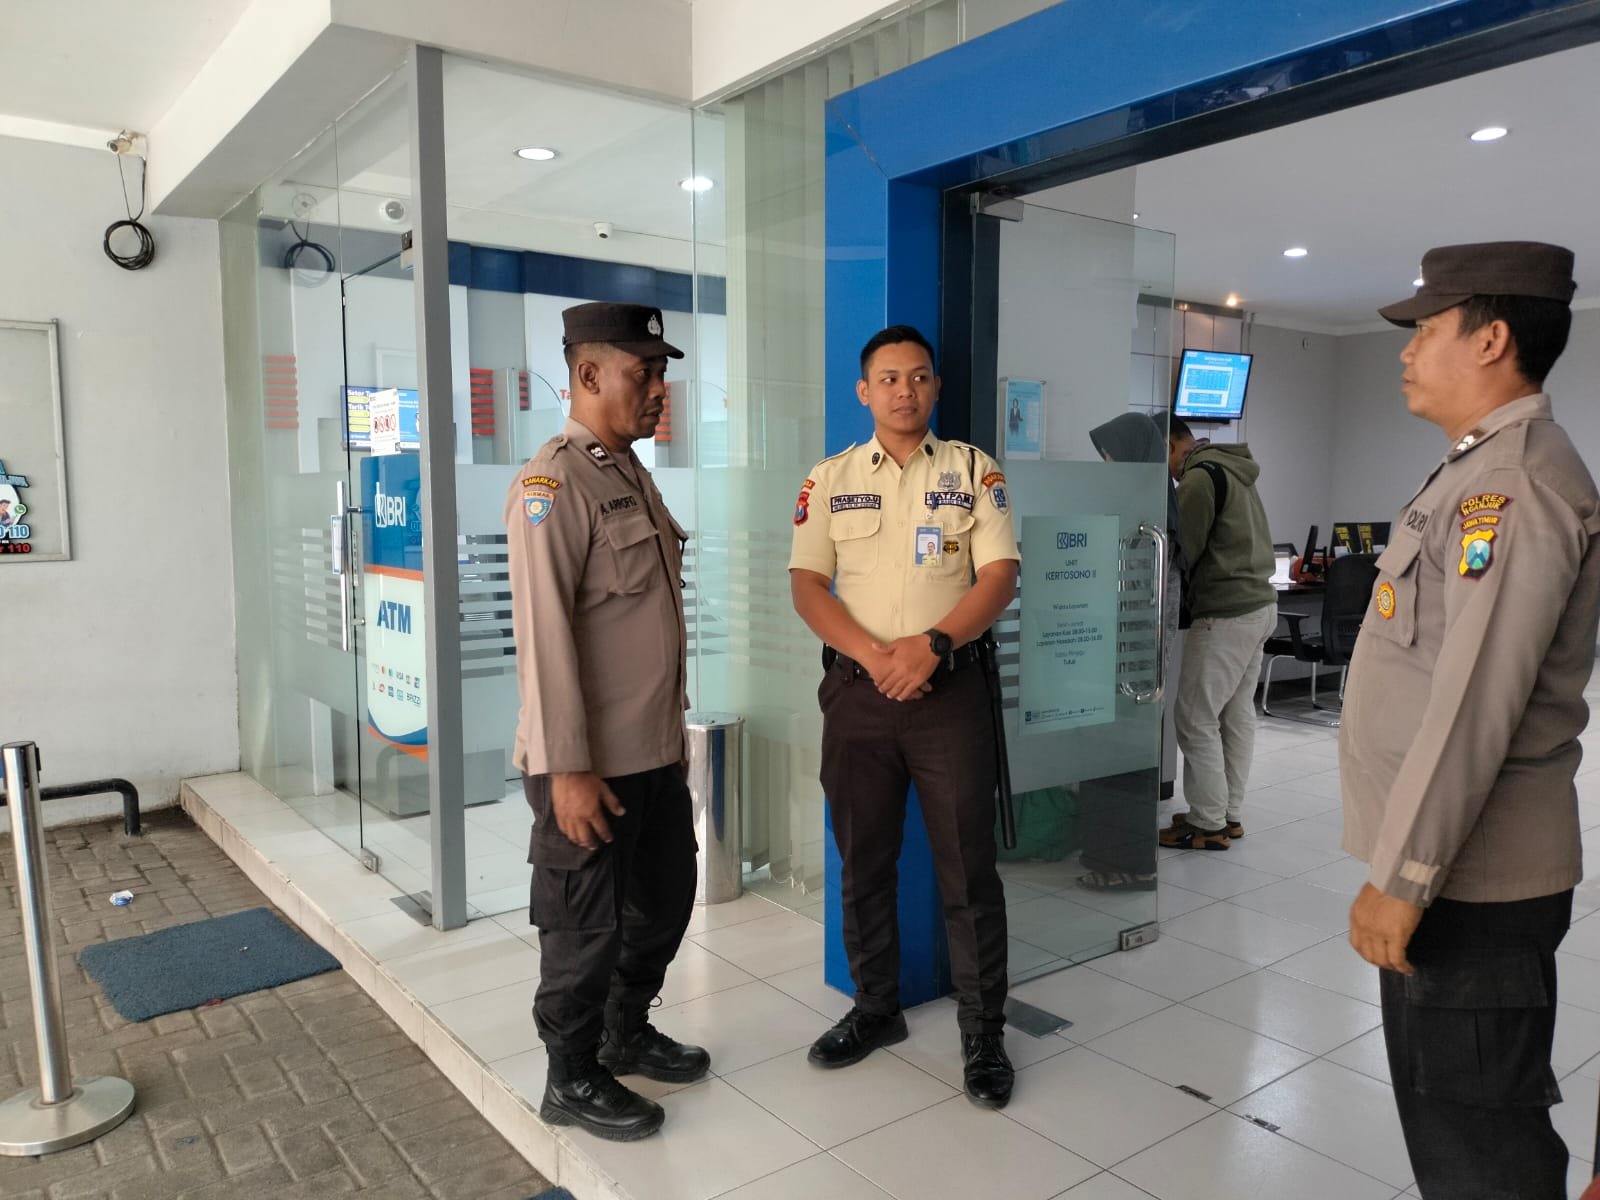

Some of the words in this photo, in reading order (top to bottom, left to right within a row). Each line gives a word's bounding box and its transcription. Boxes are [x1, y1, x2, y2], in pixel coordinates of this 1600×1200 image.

[1461, 494, 1506, 508] POLRES
[386, 496, 407, 527] BRI
[1069, 532, 1087, 548] BRI
[1045, 569, 1091, 581] KERTOSONO
[377, 600, 411, 634] ATM
